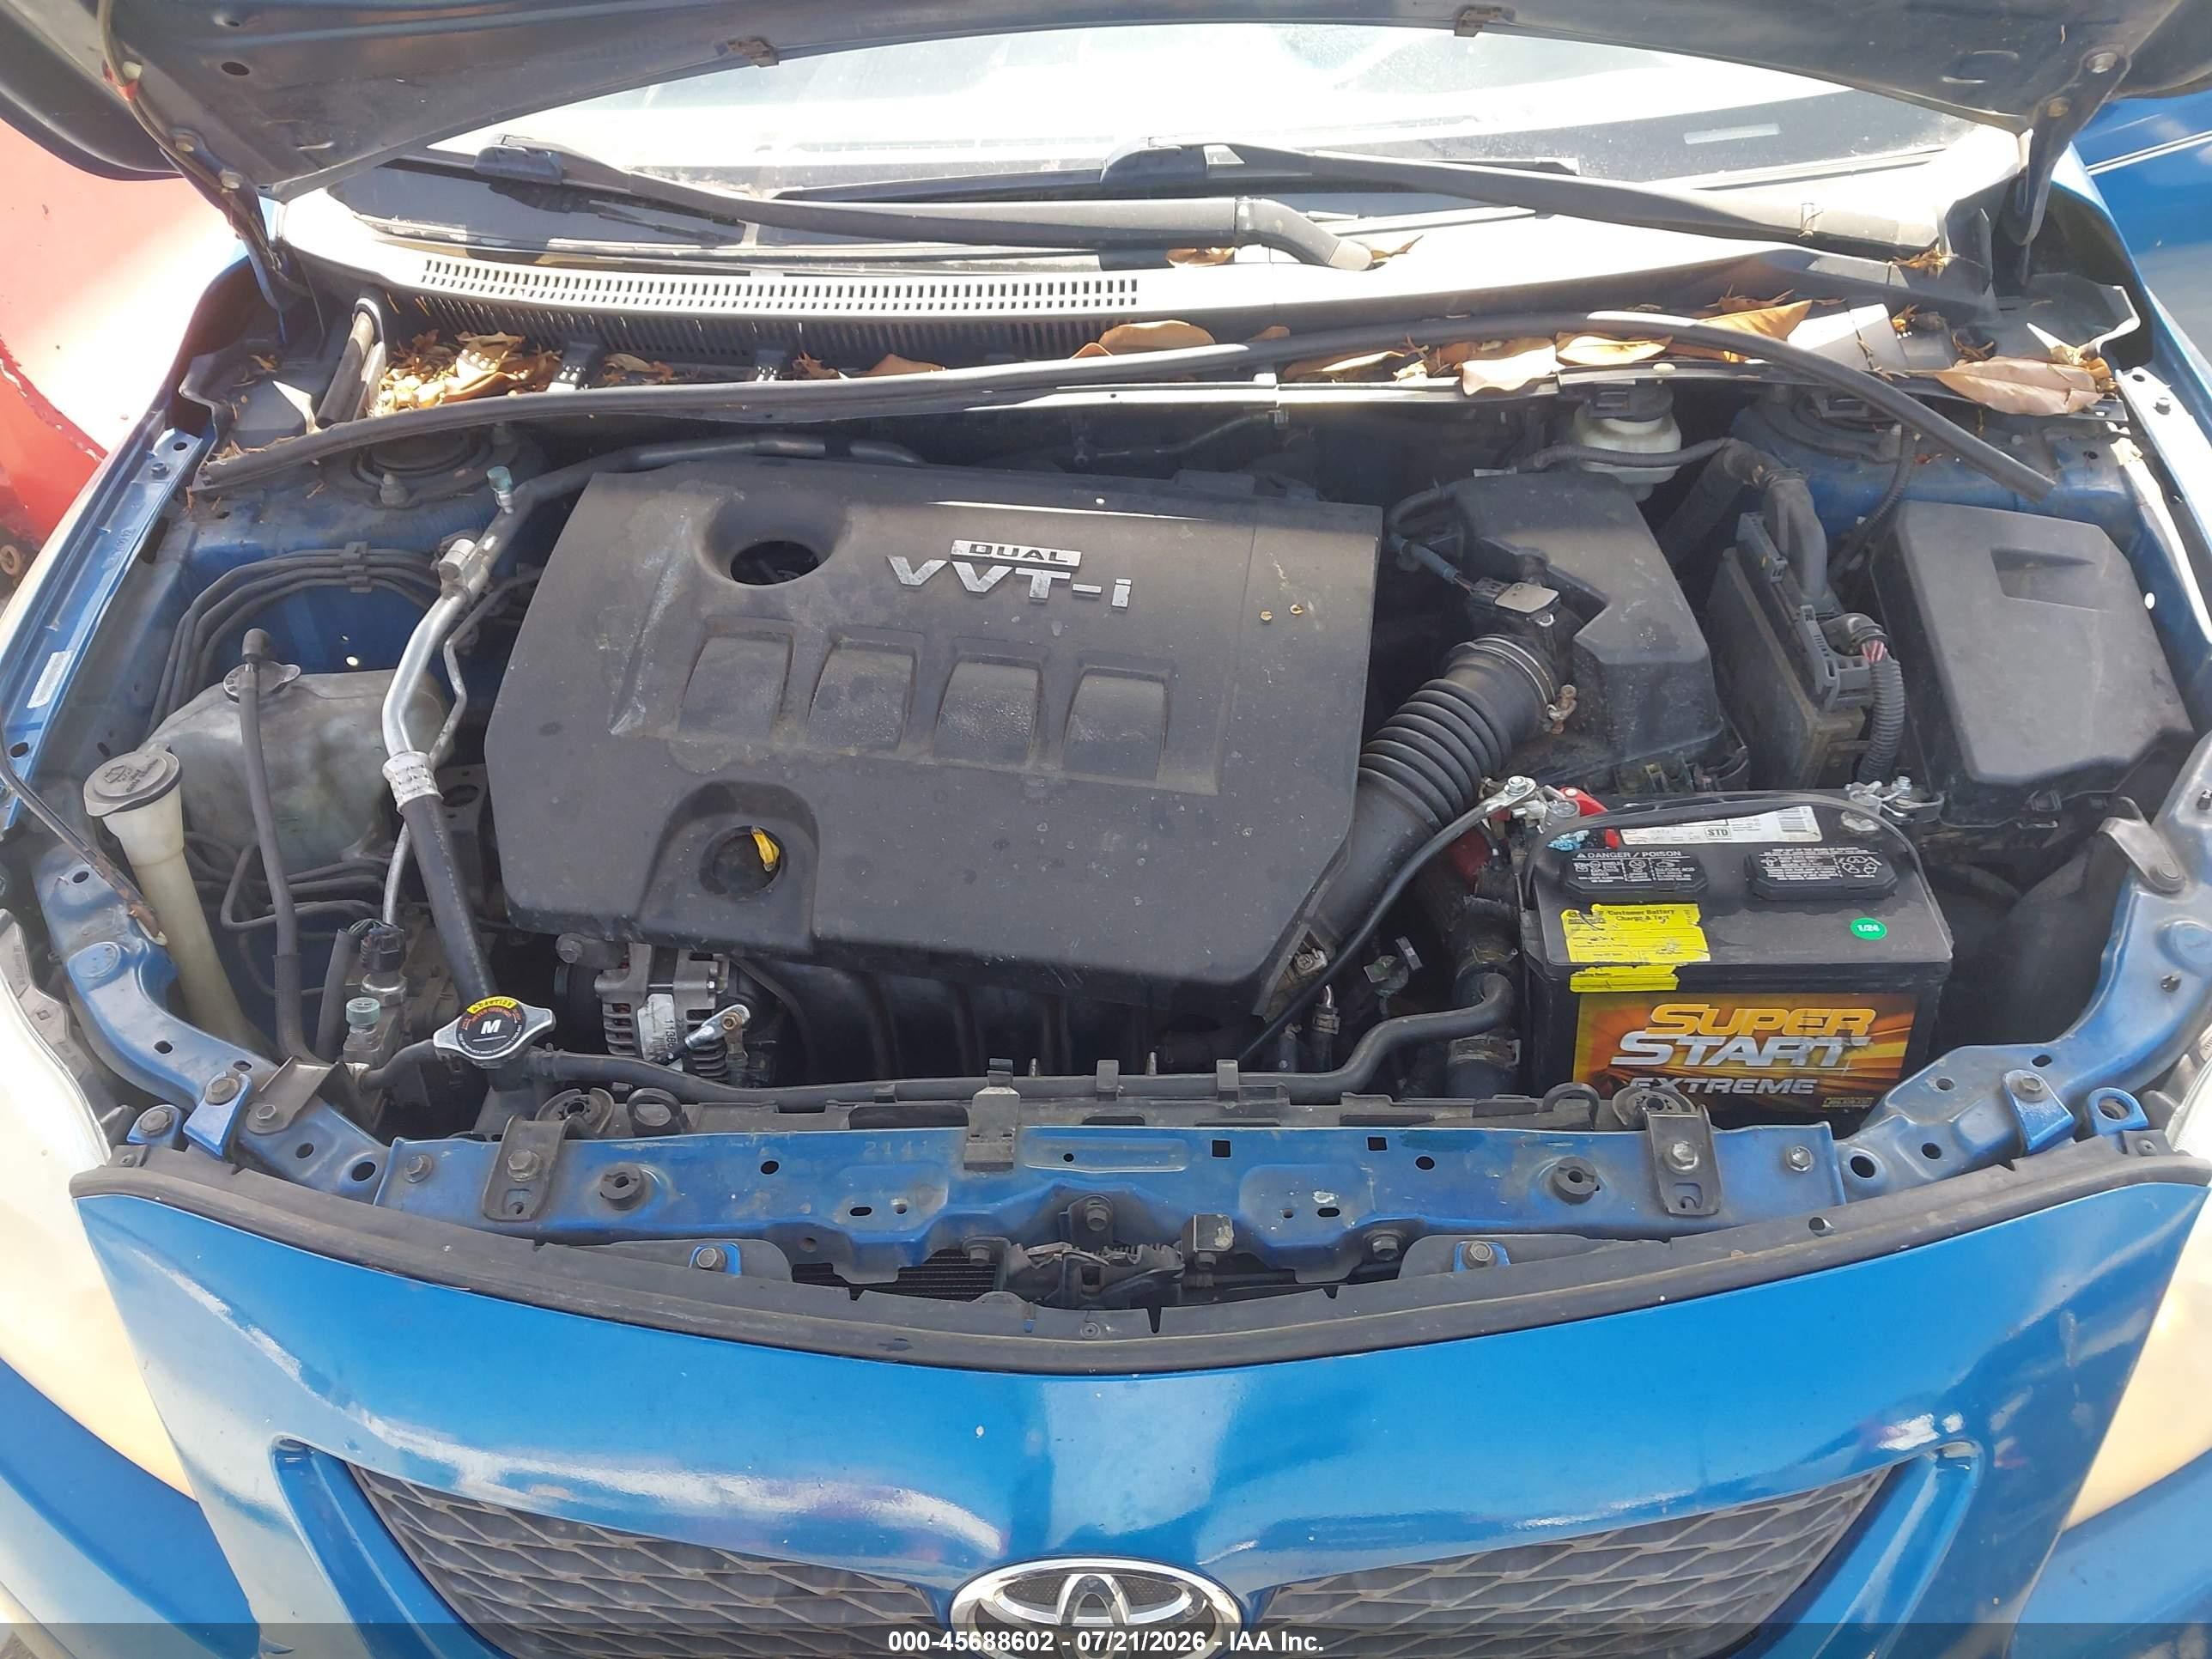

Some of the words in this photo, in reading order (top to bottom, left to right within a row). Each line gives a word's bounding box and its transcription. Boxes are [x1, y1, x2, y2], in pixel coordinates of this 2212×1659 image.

[969, 543, 1068, 563] DUAL
[886, 555, 1133, 608] VVT-i
[1708, 828, 1729, 836] STD
[1645, 1003, 1876, 1036] SUPER
[1610, 1030, 1873, 1067] START
